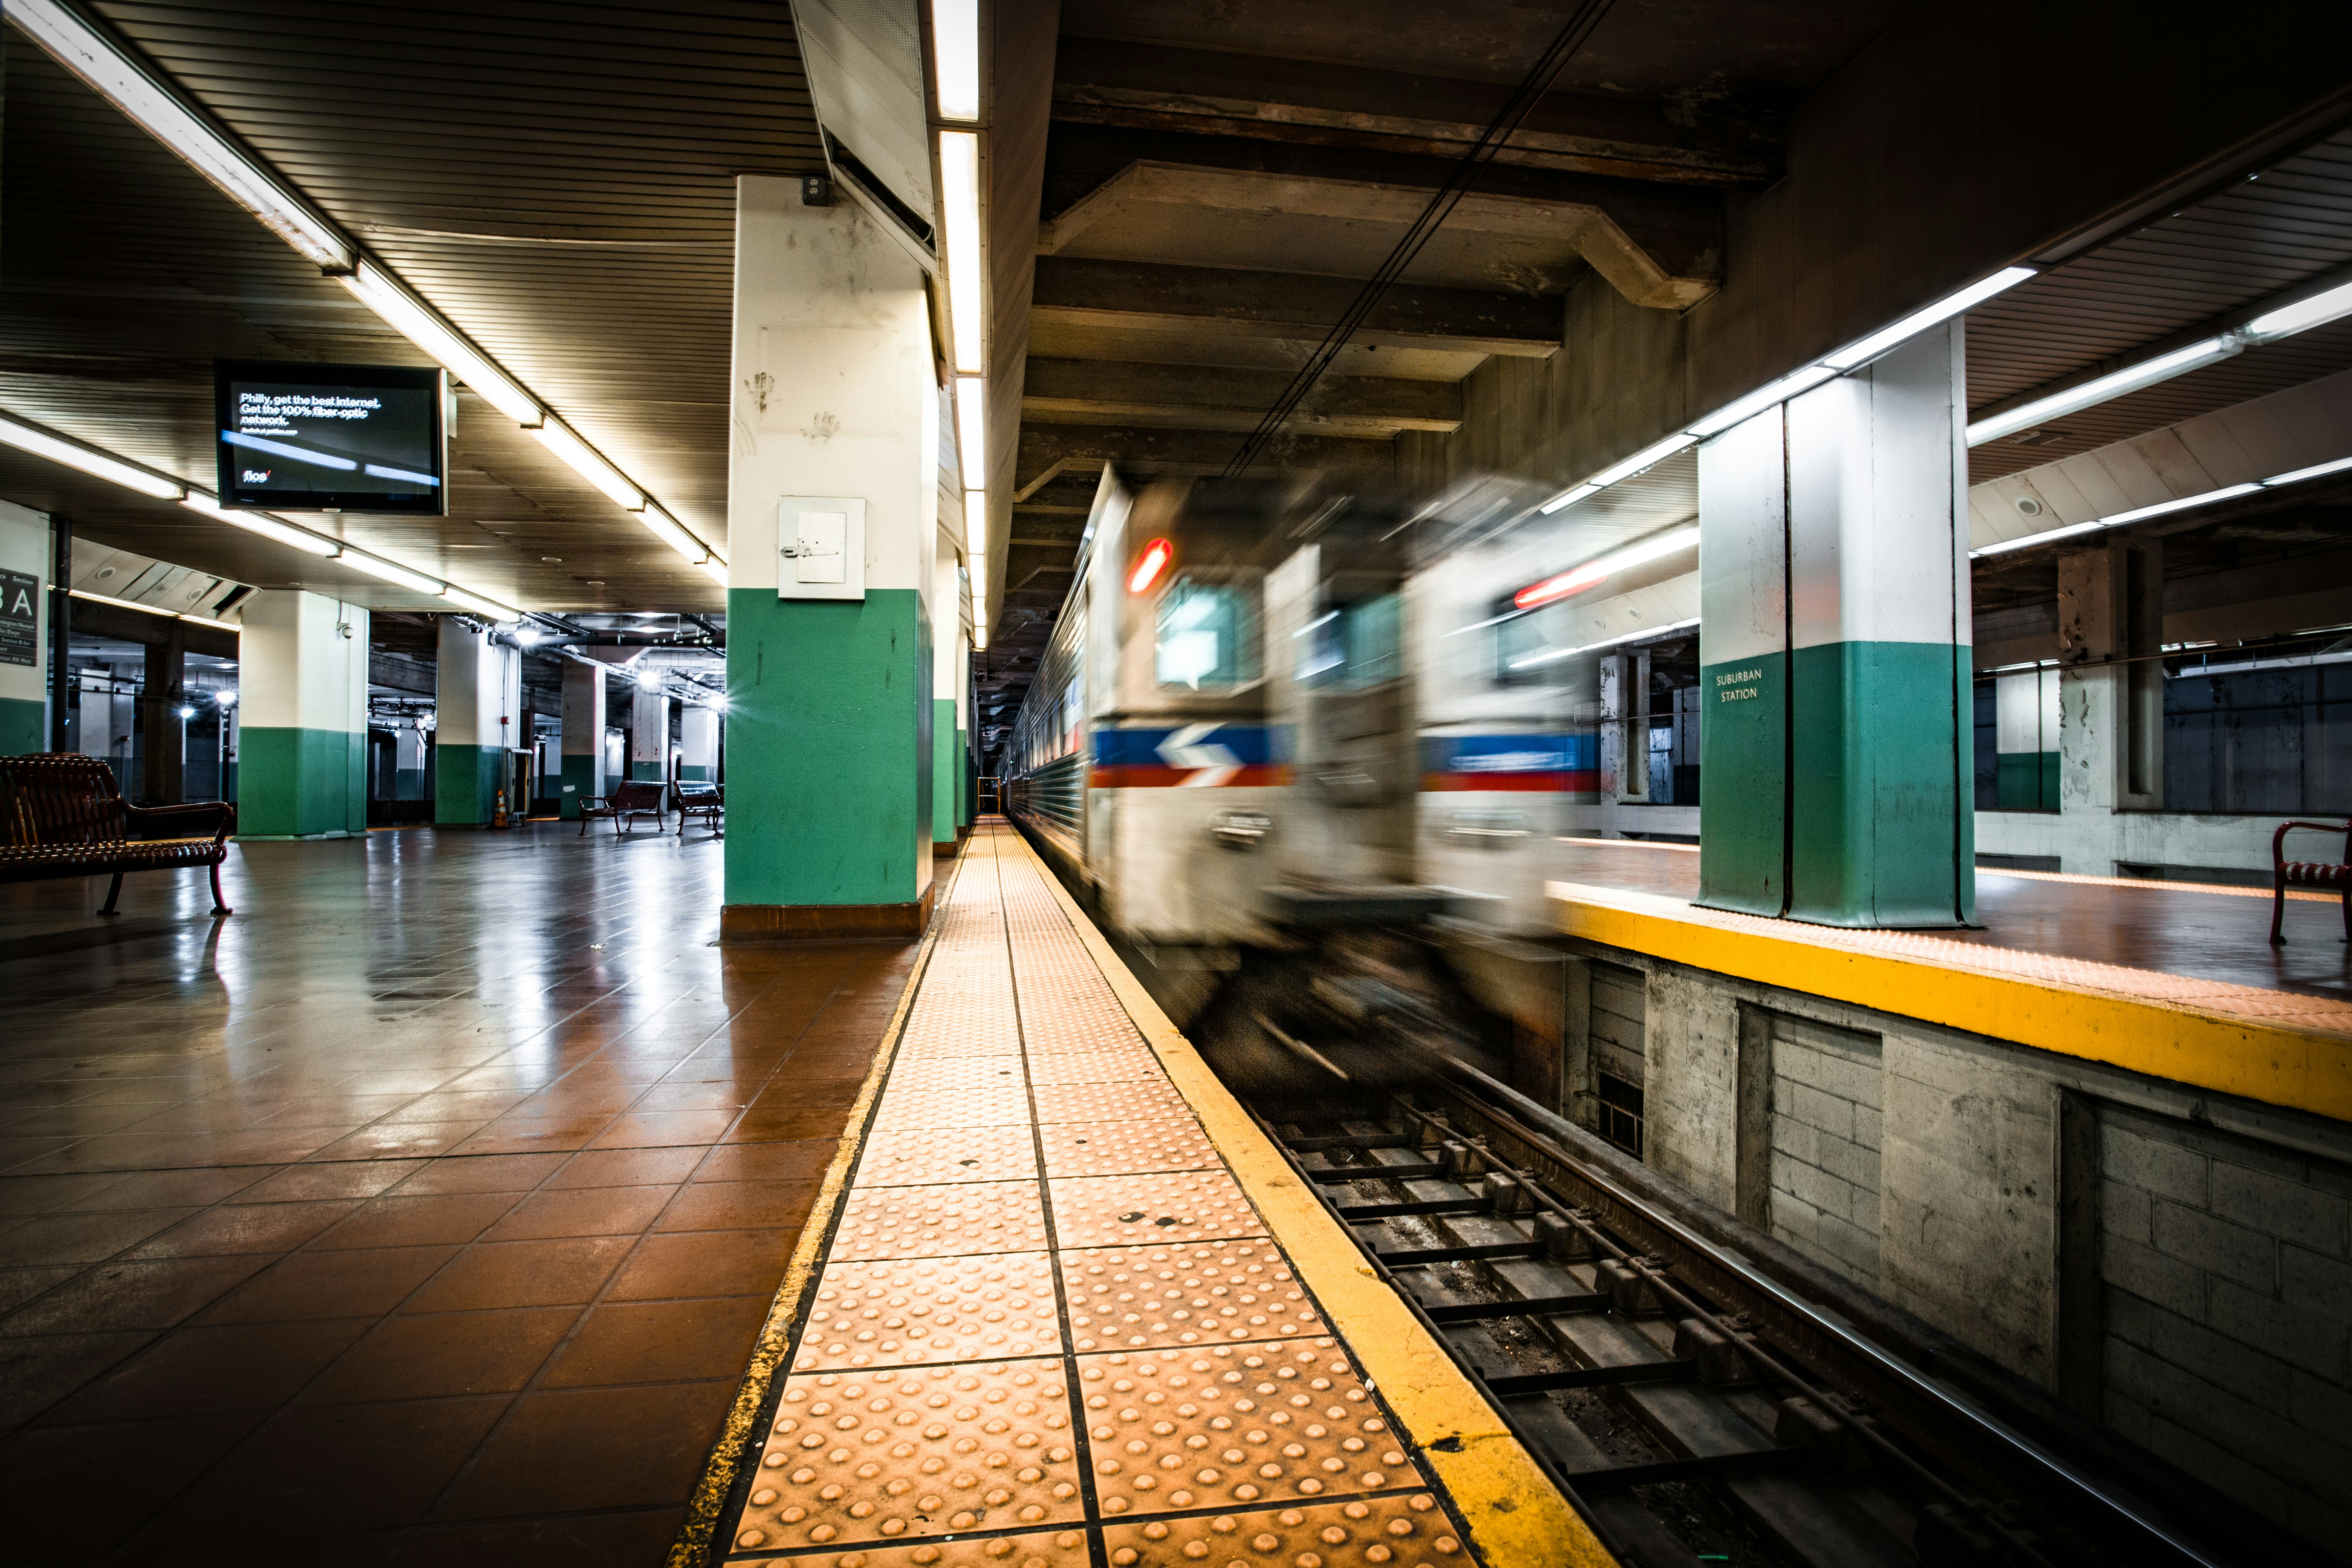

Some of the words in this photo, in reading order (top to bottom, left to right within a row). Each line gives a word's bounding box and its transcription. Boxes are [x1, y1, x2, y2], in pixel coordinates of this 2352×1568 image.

[240, 393, 273, 406] Philly,
[273, 395, 292, 406] get
[292, 395, 311, 406] the
[311, 395, 335, 406] best
[336, 396, 381, 408] internet.
[240, 403, 261, 414] Get
[262, 404, 280, 415] the
[281, 405, 312, 417] 100%
[313, 406, 368, 420] fiber-optic
[241, 415, 289, 425] network.
[243, 470, 268, 482] fios
[13, 576, 34, 585] Section
[12, 589, 32, 616] A
[1717, 669, 1761, 686] SUBURBAN
[1721, 687, 1757, 703] STATION
